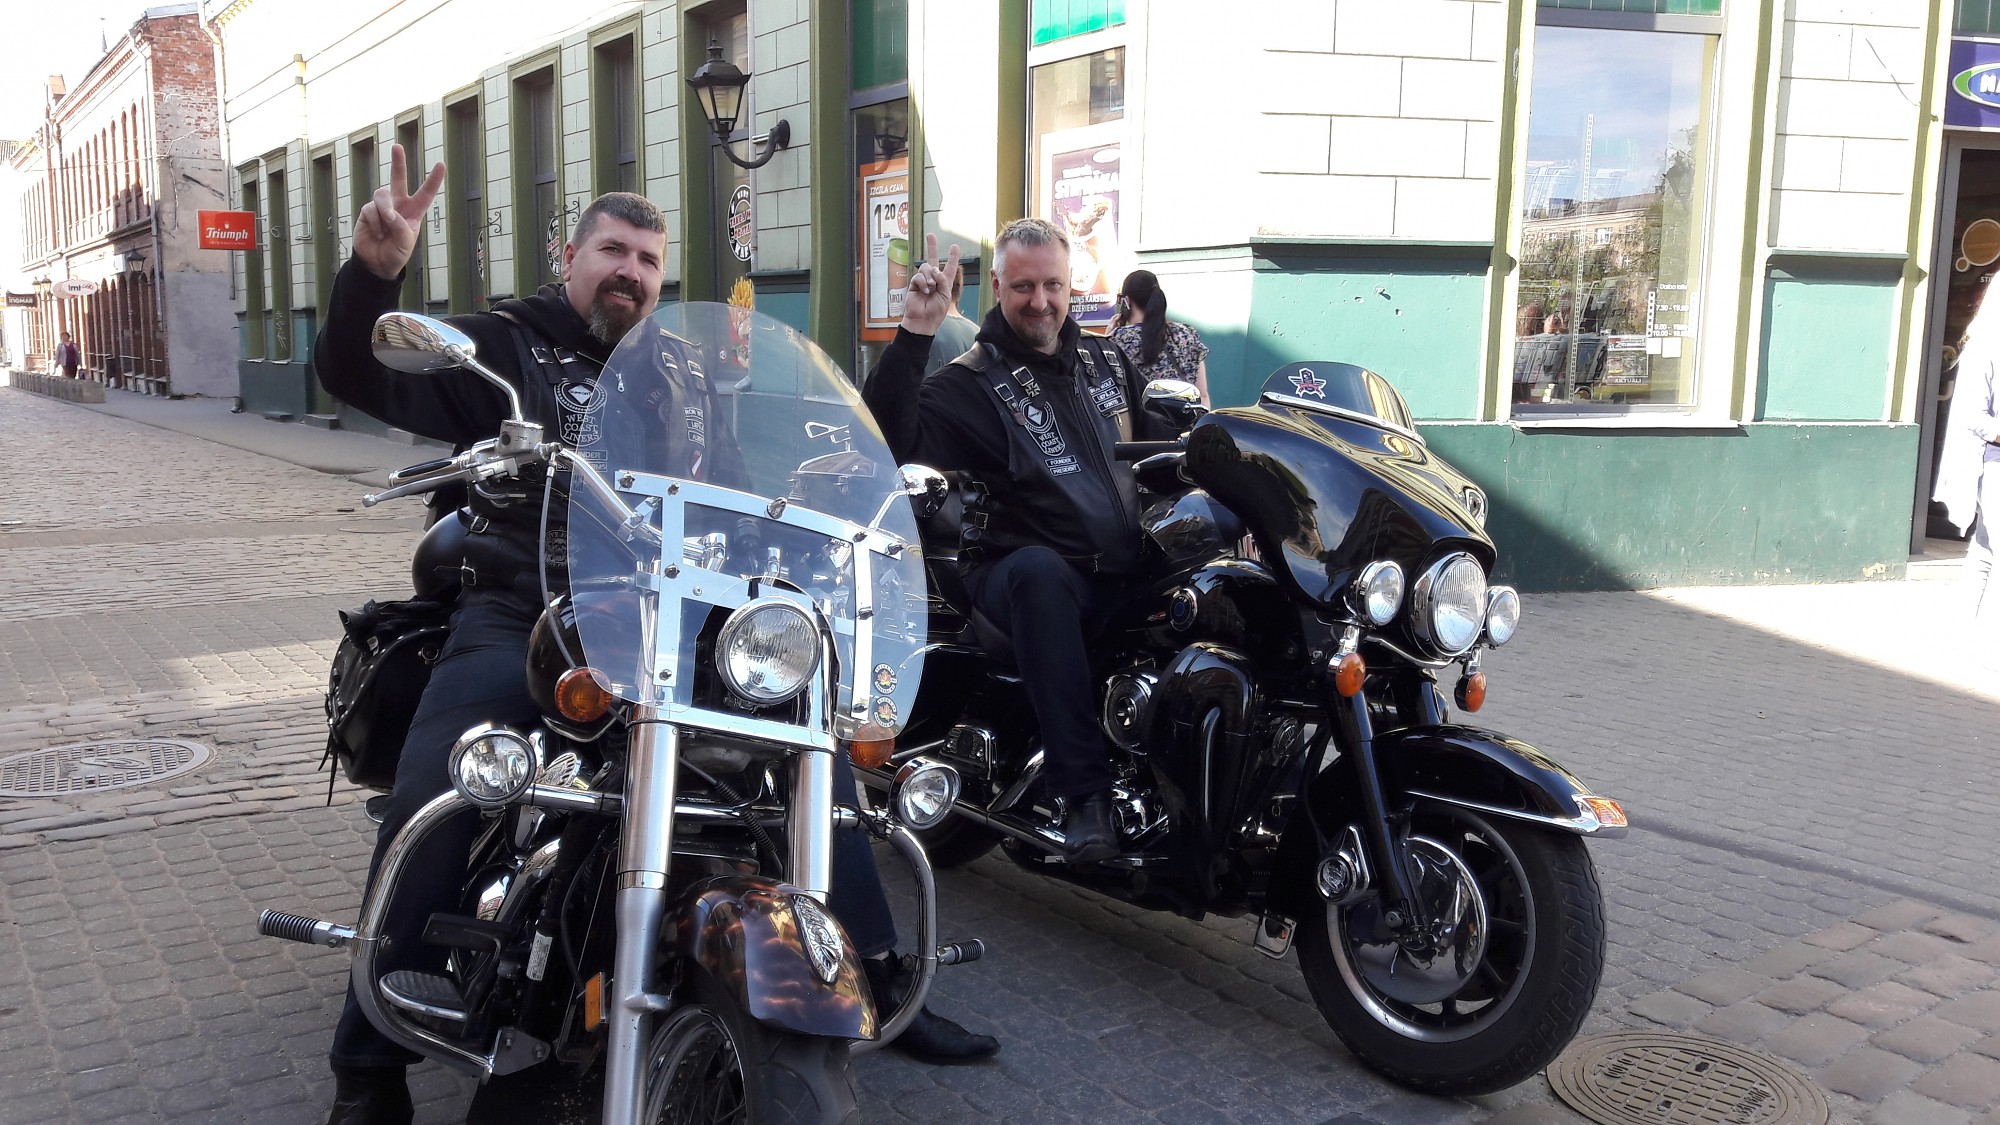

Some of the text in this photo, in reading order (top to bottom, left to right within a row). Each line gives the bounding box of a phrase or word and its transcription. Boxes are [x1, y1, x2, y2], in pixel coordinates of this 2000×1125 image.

[205, 227, 249, 242] Triumph
[565, 413, 596, 424] WEST
[564, 422, 598, 432] COAST
[562, 430, 600, 442] LINERS
[1038, 431, 1055, 441] WEST
[1041, 436, 1060, 448] COAST
